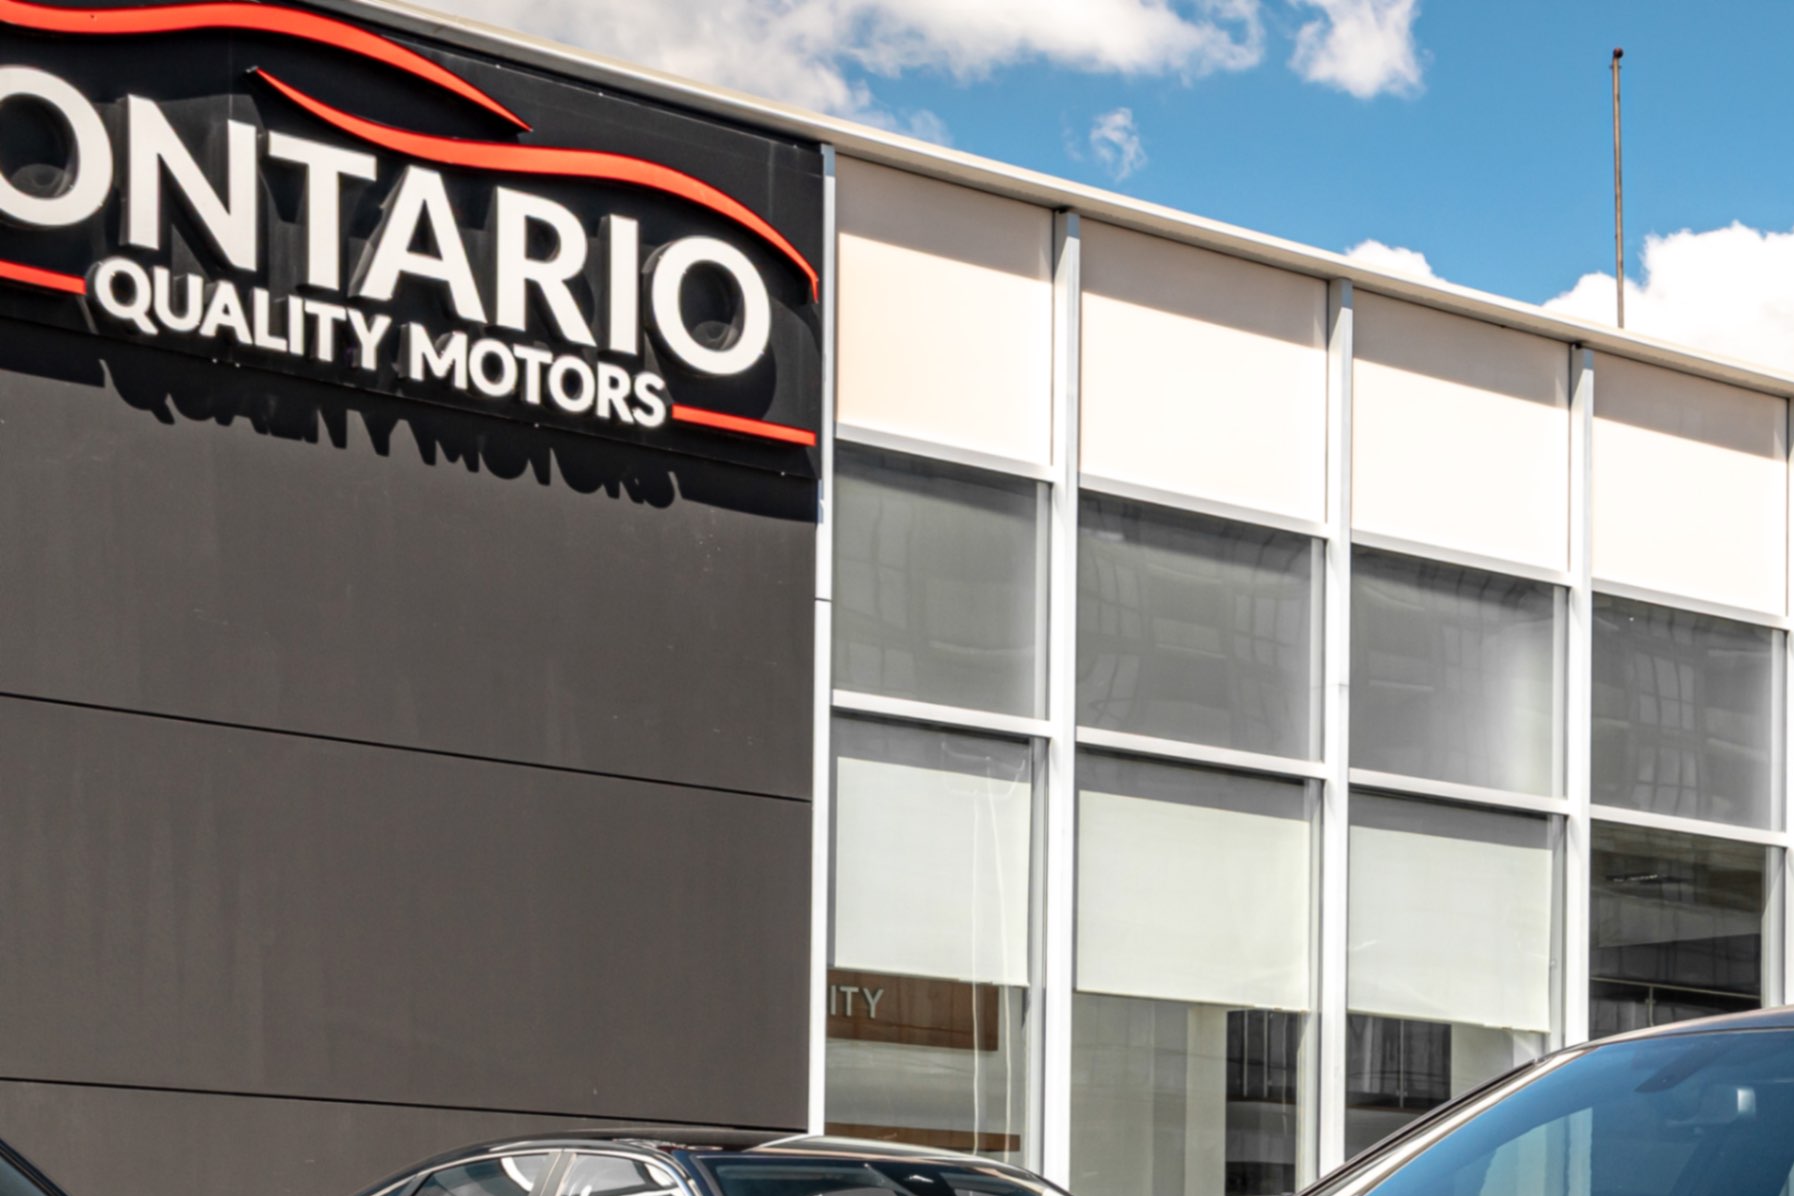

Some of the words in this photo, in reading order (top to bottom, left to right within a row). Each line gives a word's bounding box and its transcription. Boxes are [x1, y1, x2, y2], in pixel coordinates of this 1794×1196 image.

[0, 66, 771, 375] ONTARIO
[93, 257, 390, 370] QUALITY
[410, 325, 666, 428] MOTORS
